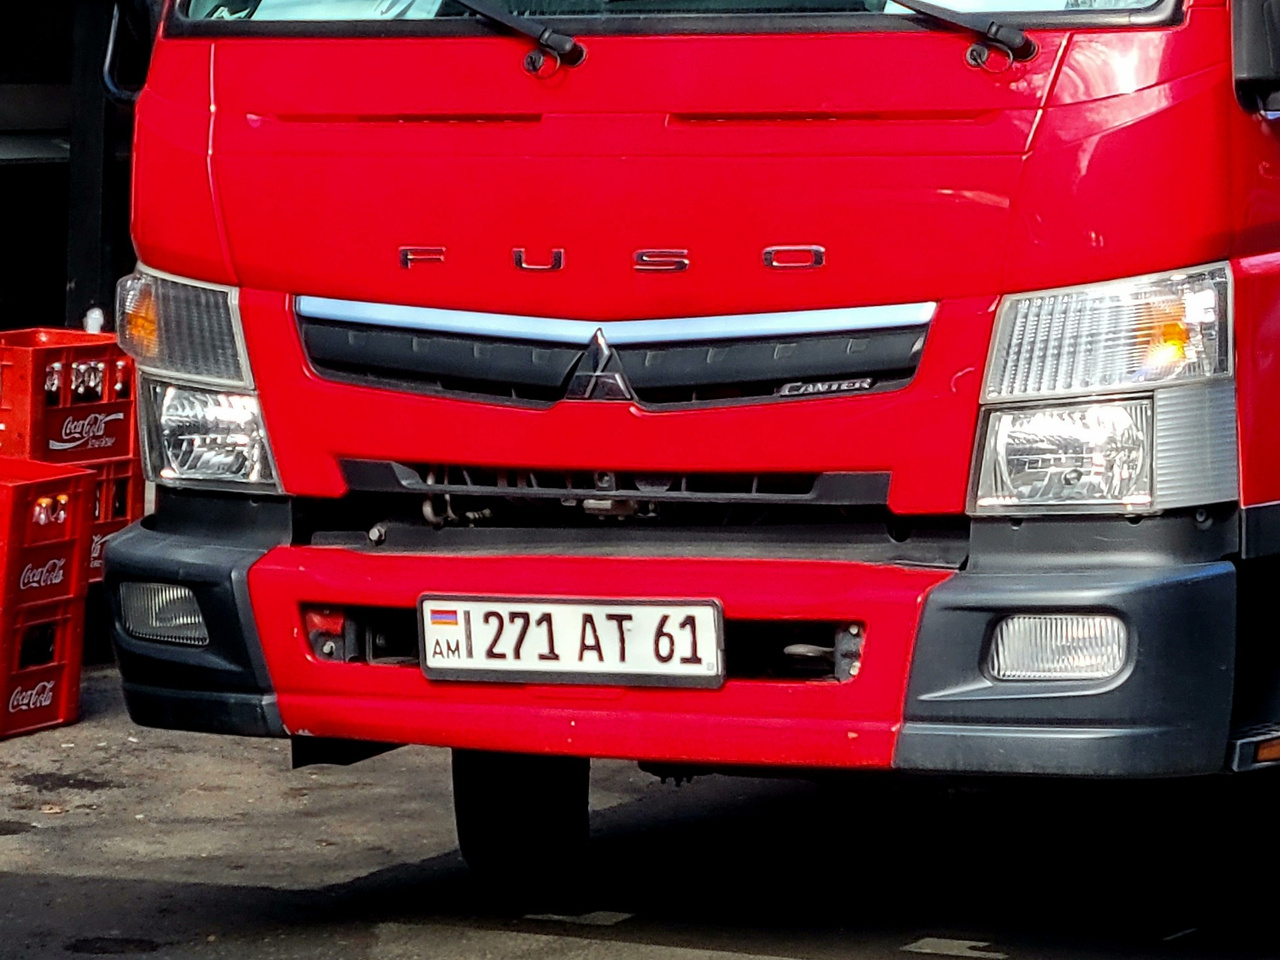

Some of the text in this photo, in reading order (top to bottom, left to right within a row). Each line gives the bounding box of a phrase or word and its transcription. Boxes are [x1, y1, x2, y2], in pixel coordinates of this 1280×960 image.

[399, 244, 827, 273] FUSO
[780, 378, 873, 396] CANTER
[432, 639, 461, 660] AM
[483, 610, 703, 665] 271 AT 61
